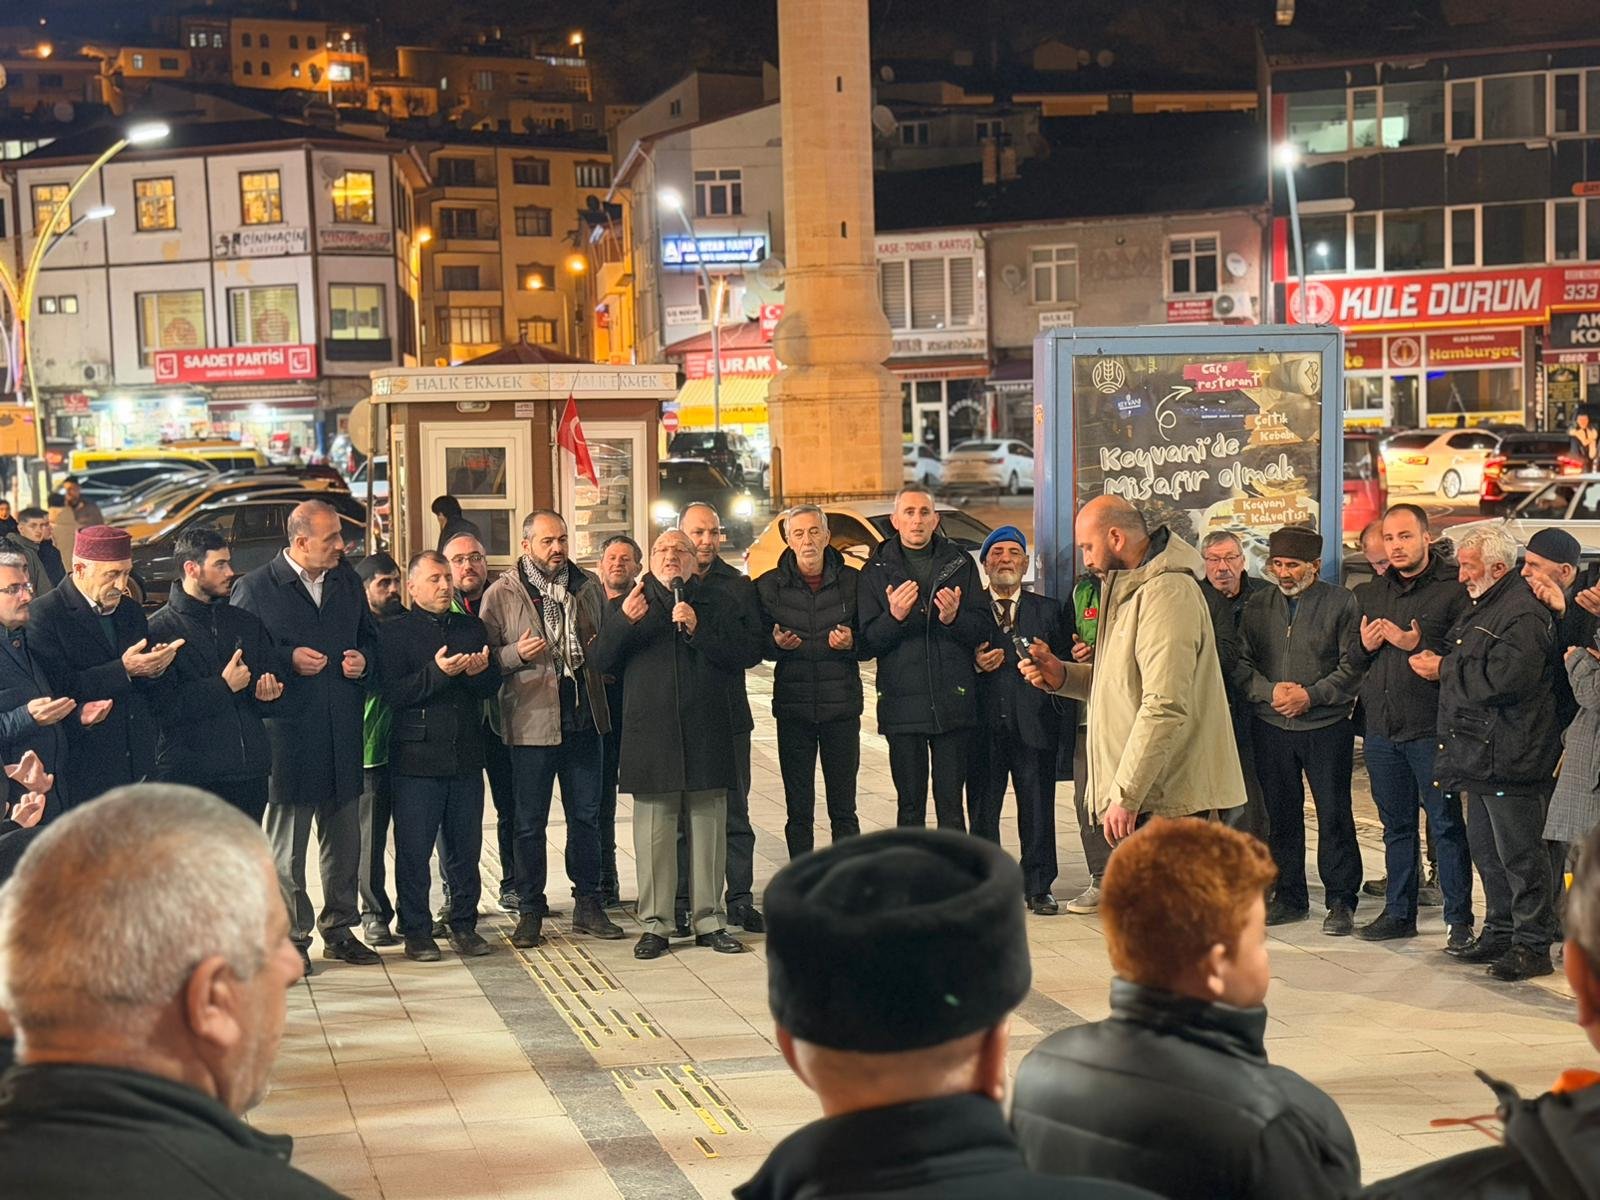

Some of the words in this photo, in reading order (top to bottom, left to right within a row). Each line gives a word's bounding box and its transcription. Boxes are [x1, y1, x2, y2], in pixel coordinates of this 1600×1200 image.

[905, 241, 932, 252] TONER
[939, 238, 971, 251] KARTUŞ
[1340, 283, 1421, 321] KULE
[1427, 278, 1542, 315] DÜRÜM
[1564, 284, 1599, 300] 333
[184, 353, 234, 369] SAADET
[236, 348, 284, 367] PARTİSİ
[1345, 350, 1364, 368] te
[1430, 345, 1518, 361] Hamburger
[707, 355, 772, 372] BURAK
[1201, 363, 1228, 375] Cafe
[416, 377, 459, 391] HALK
[464, 375, 523, 390] EKMEK
[611, 375, 657, 388] EKMEK
[995, 384, 1033, 392] TUHAF
[1100, 432, 1240, 480] Keyvani'de
[1104, 470, 1209, 500] Misafir
[1218, 454, 1295, 489] olmak
[1242, 497, 1286, 515] Keyvani
